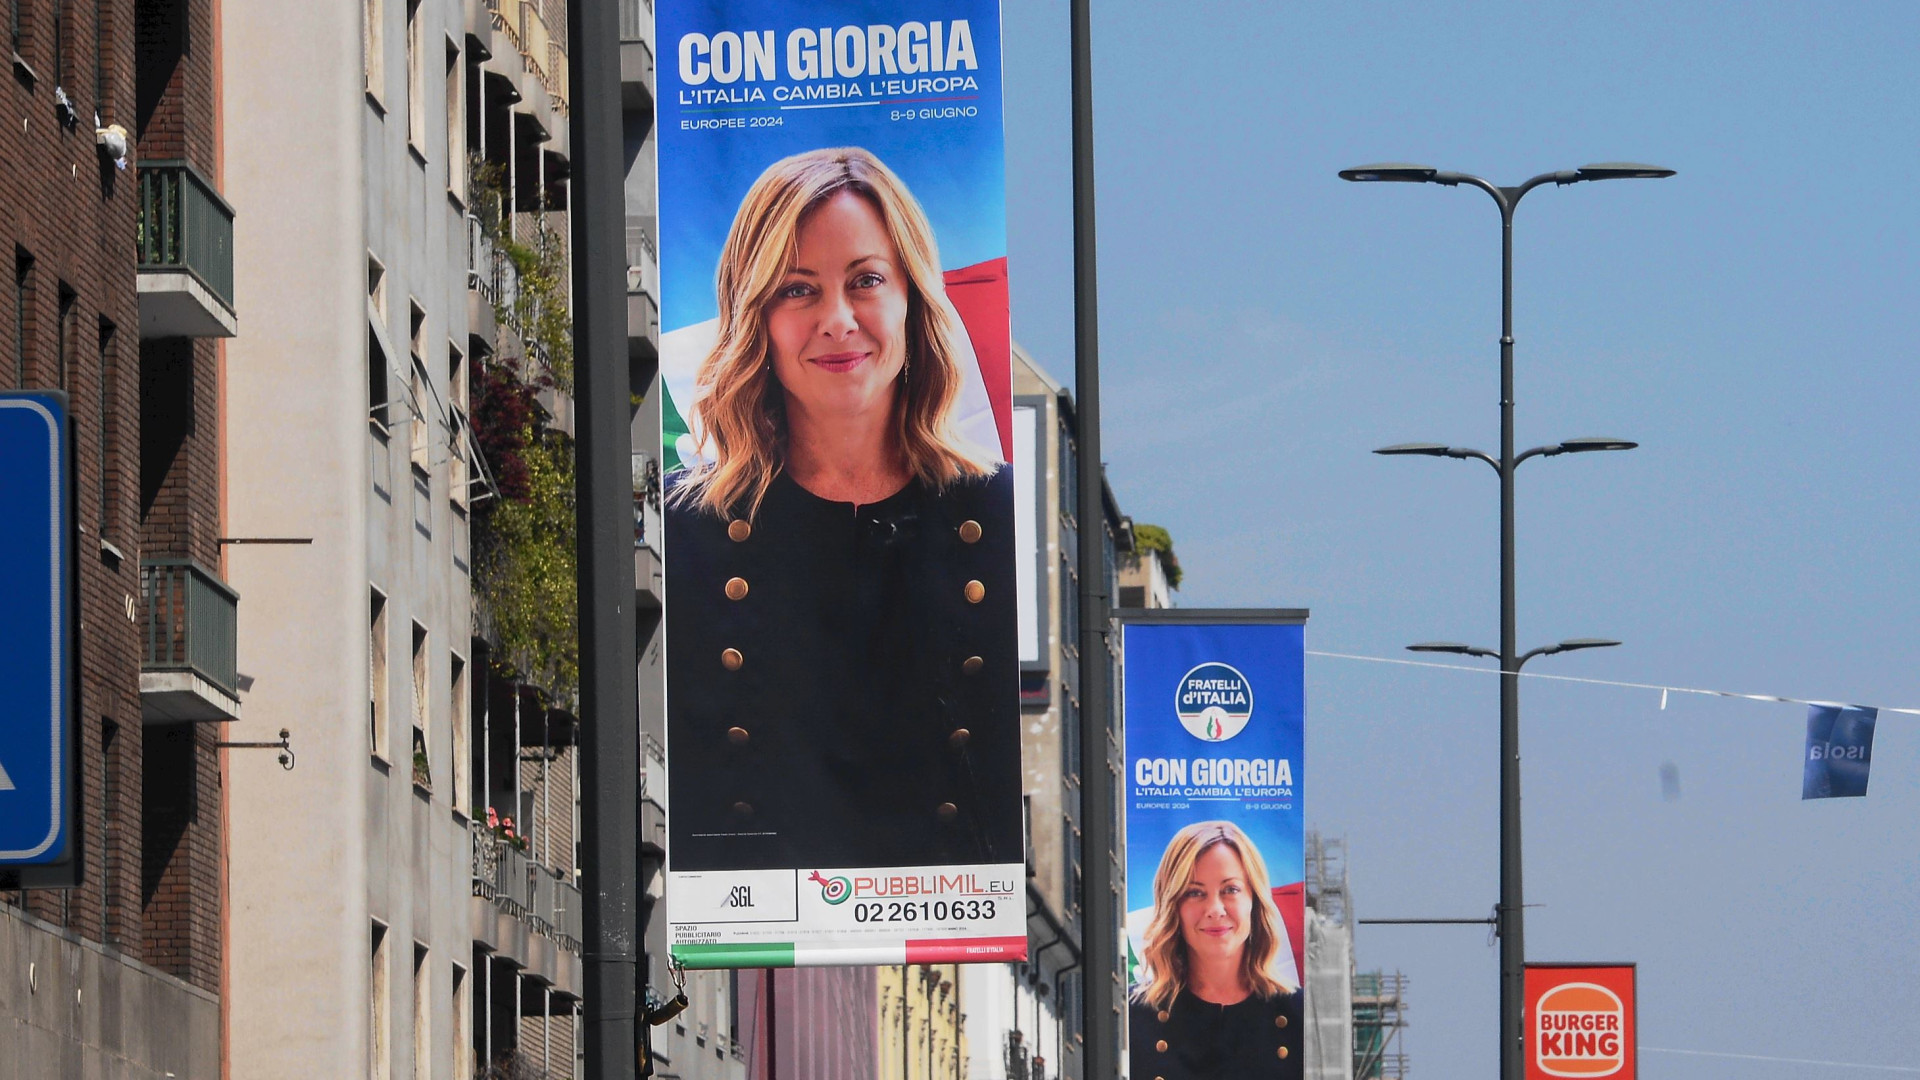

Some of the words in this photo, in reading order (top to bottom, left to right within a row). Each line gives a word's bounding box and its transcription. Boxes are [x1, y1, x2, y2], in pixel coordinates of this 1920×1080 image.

[678, 30, 776, 86] CON
[786, 19, 979, 81] GIORGIA
[679, 87, 767, 106] L'ITALIA
[772, 83, 863, 102] CAMBIA
[870, 76, 979, 97] L'EUROPA
[919, 106, 978, 120] GIUGNO
[681, 118, 746, 130] EUROPEE
[749, 116, 784, 128] 2024
[1188, 679, 1241, 691] FRATELLI
[1182, 691, 1247, 705] d'ITALIA
[1135, 758, 1187, 786] CON
[1191, 758, 1293, 786] GIORGIA
[1135, 787, 1181, 796] L'ITALIA
[1184, 787, 1231, 796] CAMBIA
[1235, 787, 1293, 797] L'EUROPA
[730, 886, 755, 908] SGL
[1541, 1014, 1619, 1031] BURGER
[1541, 1032, 1619, 1056] KING
